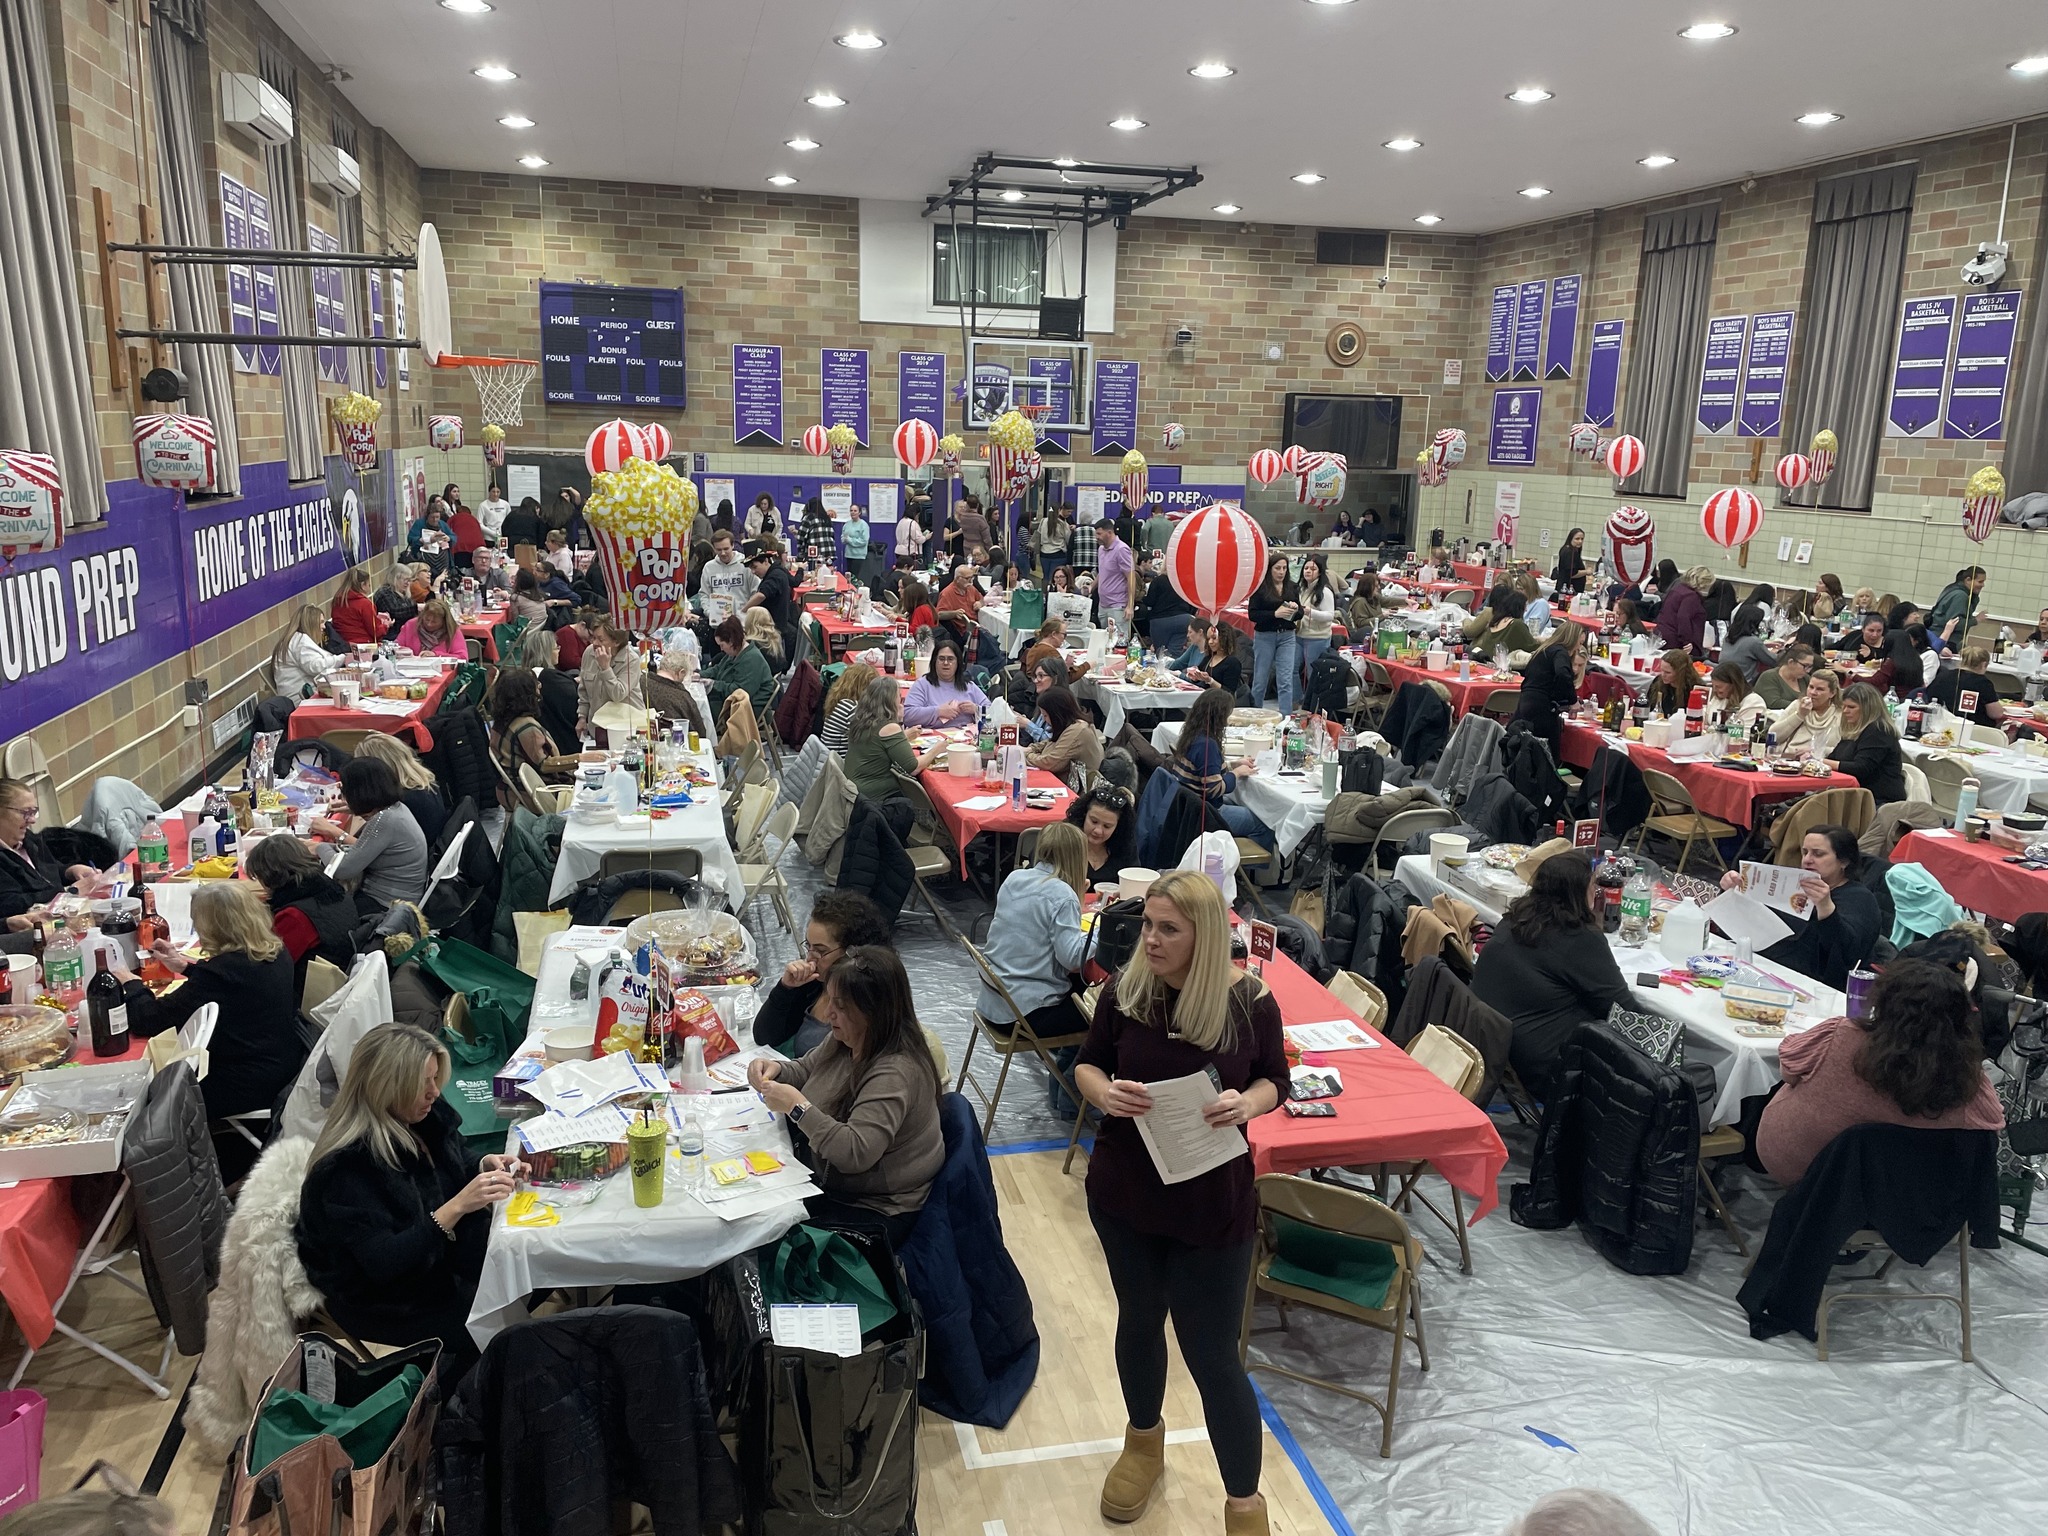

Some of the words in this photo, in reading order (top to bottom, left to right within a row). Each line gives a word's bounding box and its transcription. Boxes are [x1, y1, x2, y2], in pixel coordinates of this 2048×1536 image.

[1979, 297, 1995, 305] BOYS
[1972, 304, 2009, 312] BASKETBALL
[1911, 309, 1945, 317] BASKETBALL
[551, 316, 580, 325] HOME
[601, 322, 628, 330] PERIOD
[646, 321, 676, 330] GUEST
[589, 356, 616, 364] PLAYER
[352, 429, 372, 442] POP
[150, 441, 193, 450] WELCOME
[833, 449, 844, 458] POP
[147, 459, 201, 473] CARNIVAL
[1, 490, 37, 502] COME
[1168, 492, 1200, 504] PREP
[4, 508, 20, 516] THE
[194, 517, 247, 602] HOME
[248, 514, 266, 580] OF
[268, 506, 294, 570] THE
[294, 497, 334, 562] EAGLES
[640, 548, 682, 580] POP
[714, 578, 742, 586] EAGLES
[0, 567, 68, 681] UND
[72, 547, 139, 652] PREP
[1578, 831, 1594, 839] 37
[1768, 881, 1777, 896] CARD
[1254, 936, 1271, 950] 38
[675, 996, 701, 1012] Sun
[699, 1017, 716, 1028] GARDEN
[705, 1022, 718, 1030] SALSA
[634, 1158, 660, 1177] GRINCH
